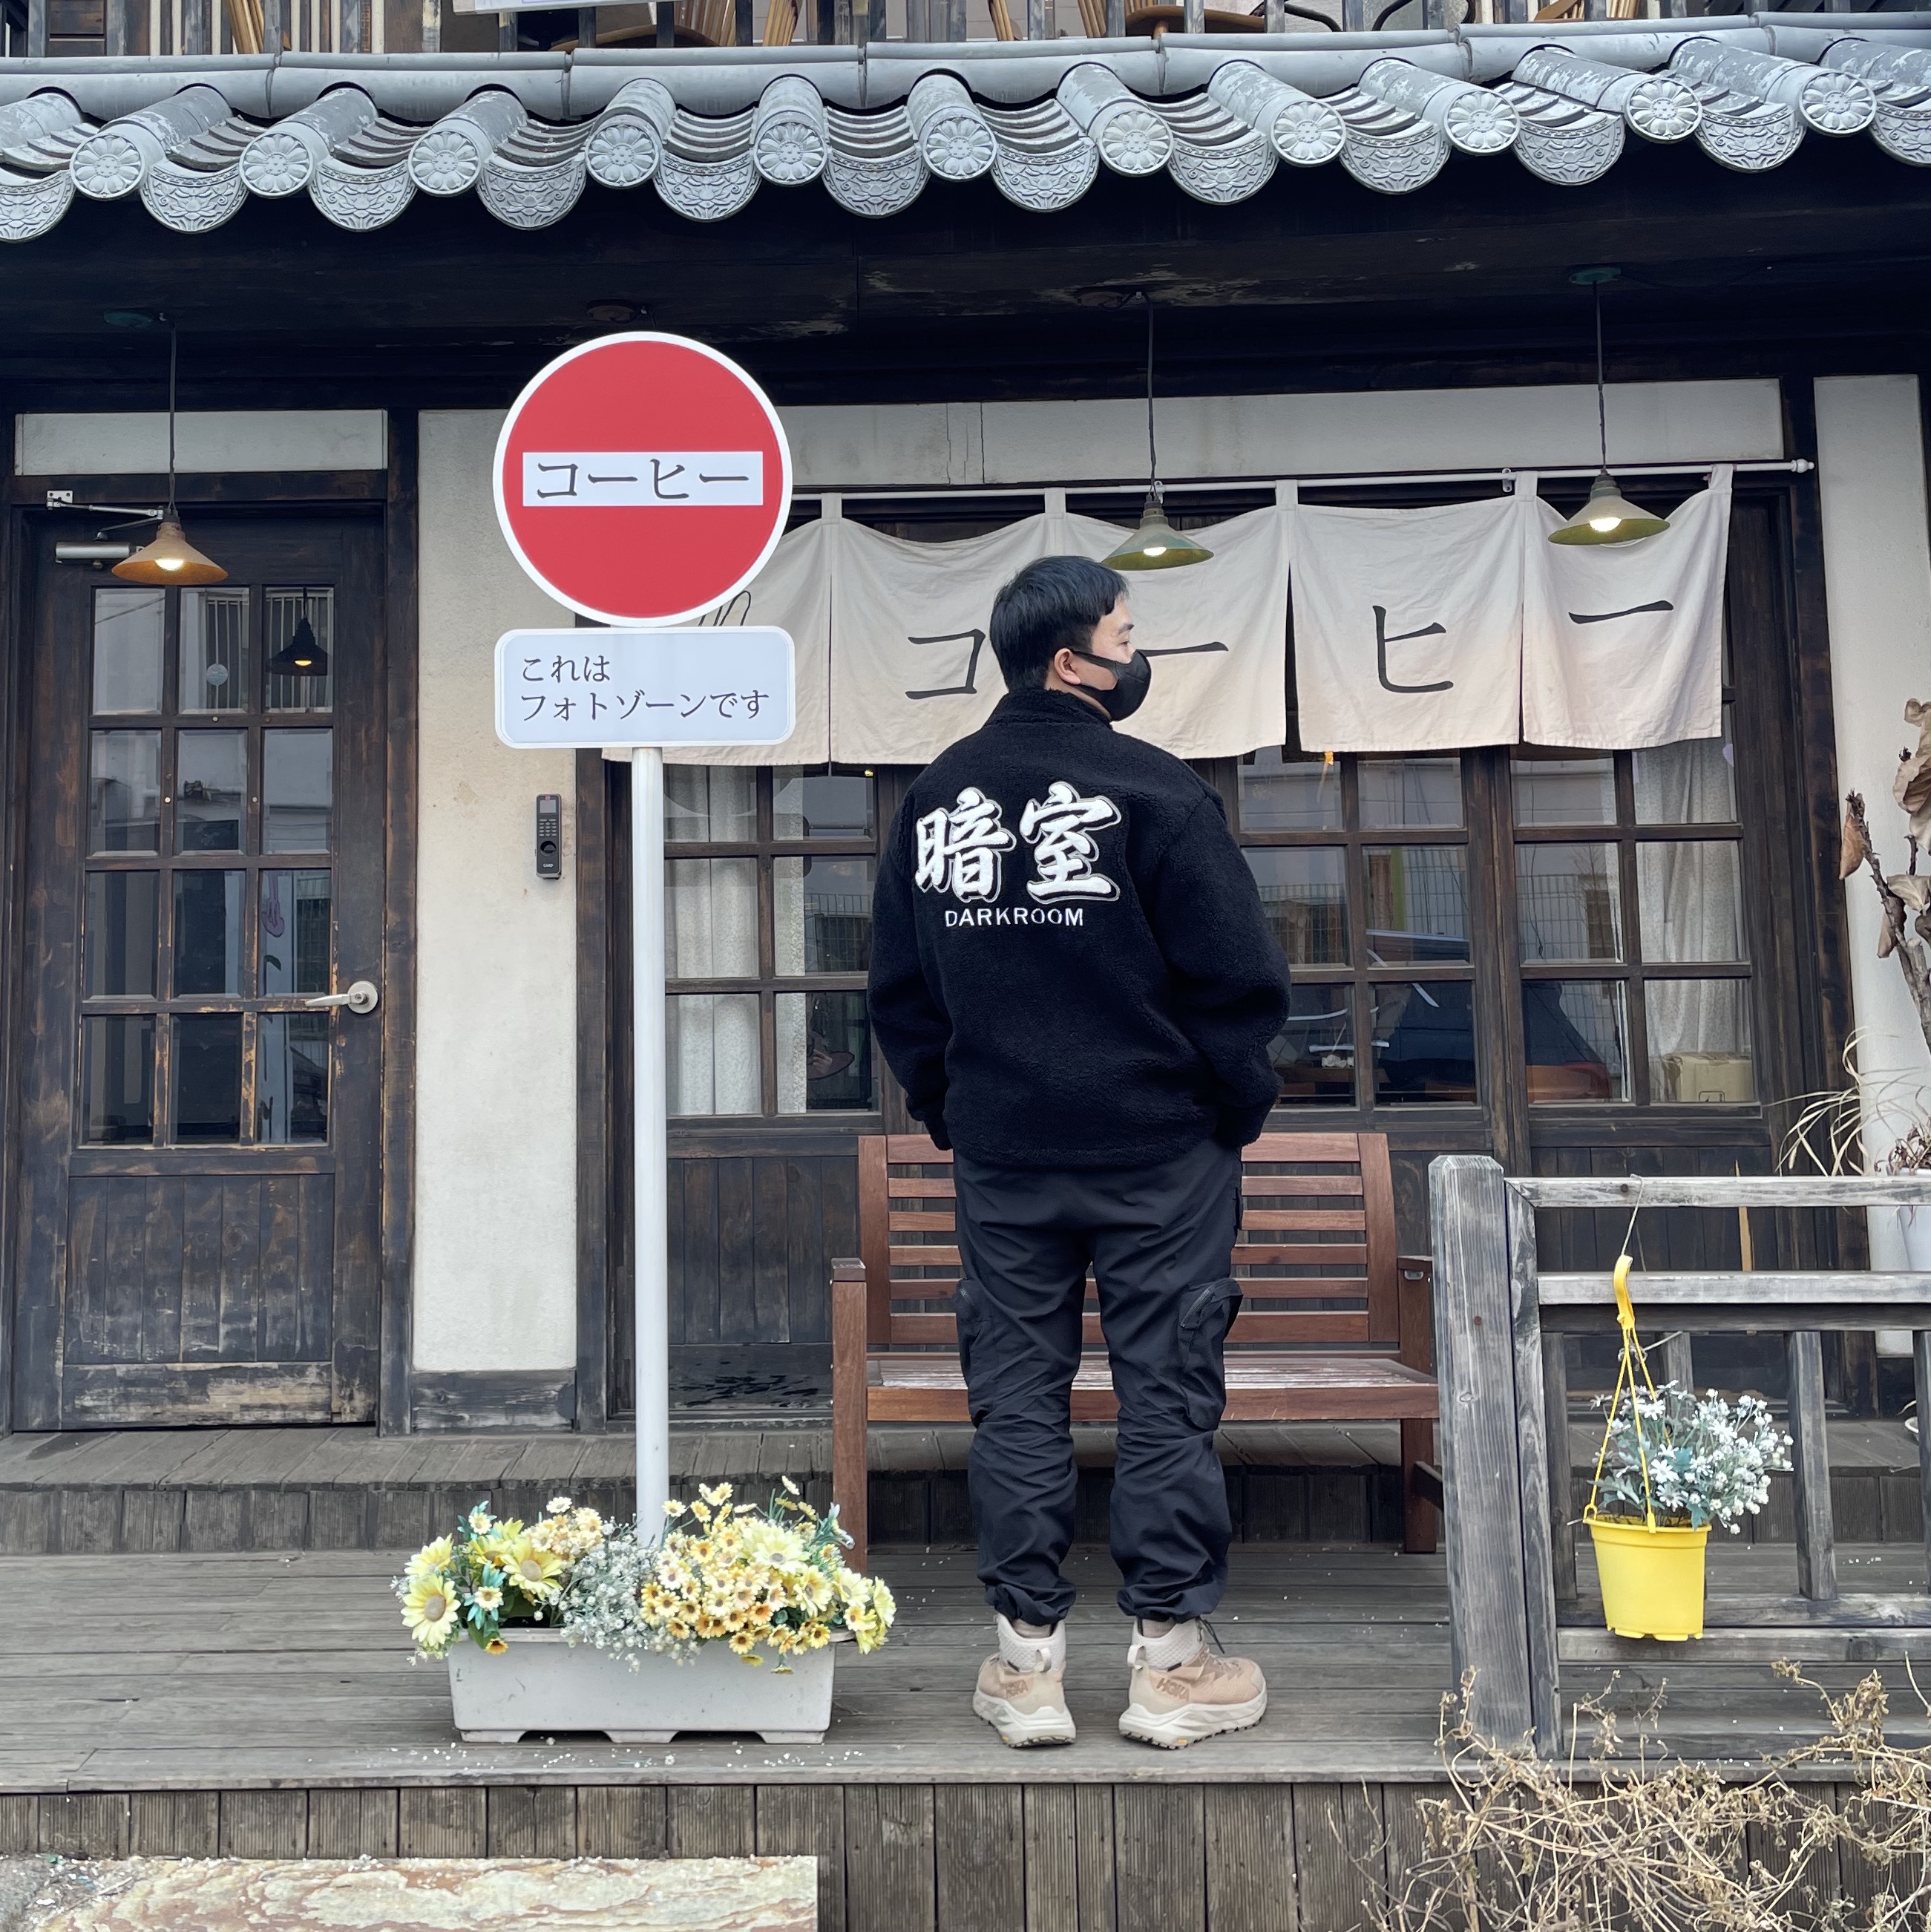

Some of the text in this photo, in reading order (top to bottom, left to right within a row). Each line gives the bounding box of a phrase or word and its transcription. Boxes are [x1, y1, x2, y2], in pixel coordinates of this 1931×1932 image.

[536, 458, 750, 500] コーヒー
[521, 654, 611, 683] これは
[521, 689, 770, 721] フォトゾーンです
[915, 781, 1121, 904] 暗室
[945, 907, 1083, 927] DARKROOM
